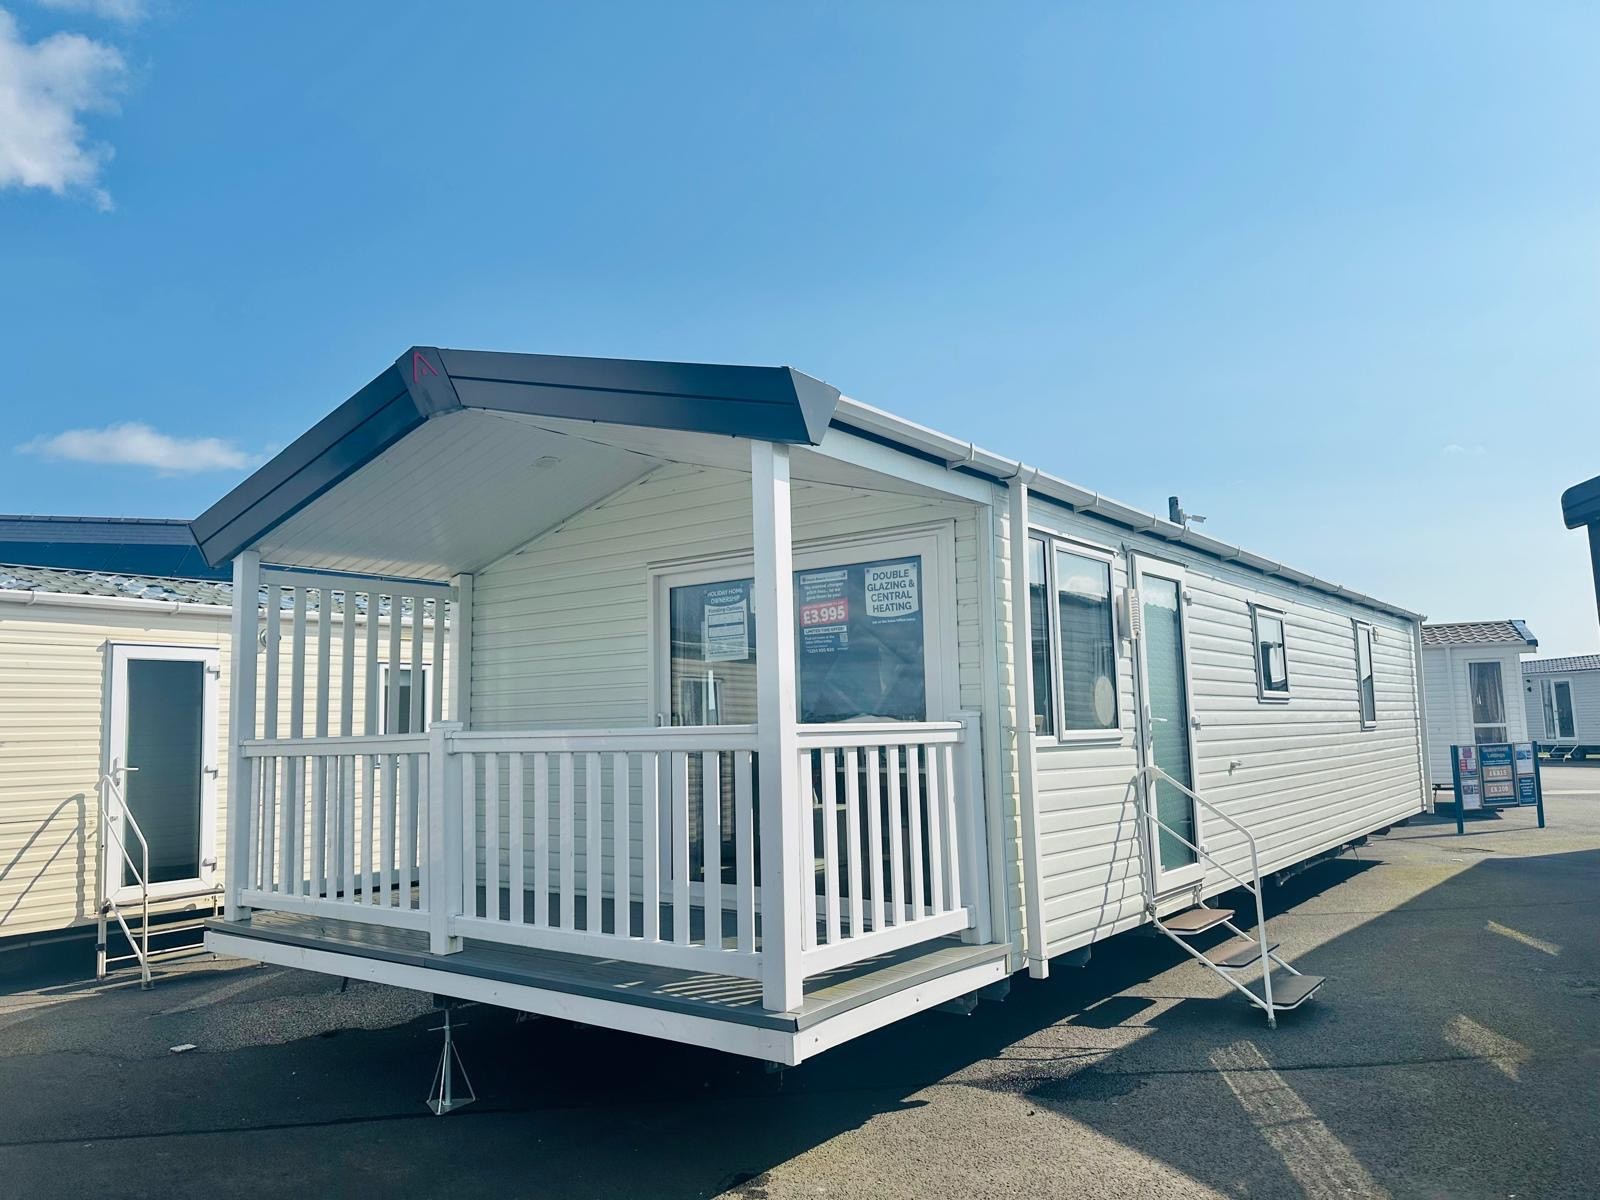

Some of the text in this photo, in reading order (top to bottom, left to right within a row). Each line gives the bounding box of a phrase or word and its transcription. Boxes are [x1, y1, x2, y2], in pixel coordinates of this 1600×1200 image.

[872, 569, 909, 581] DOUBLE
[867, 579, 915, 592] GLAZING &
[871, 590, 912, 602] CENTRAL
[872, 602, 912, 613] HEATING
